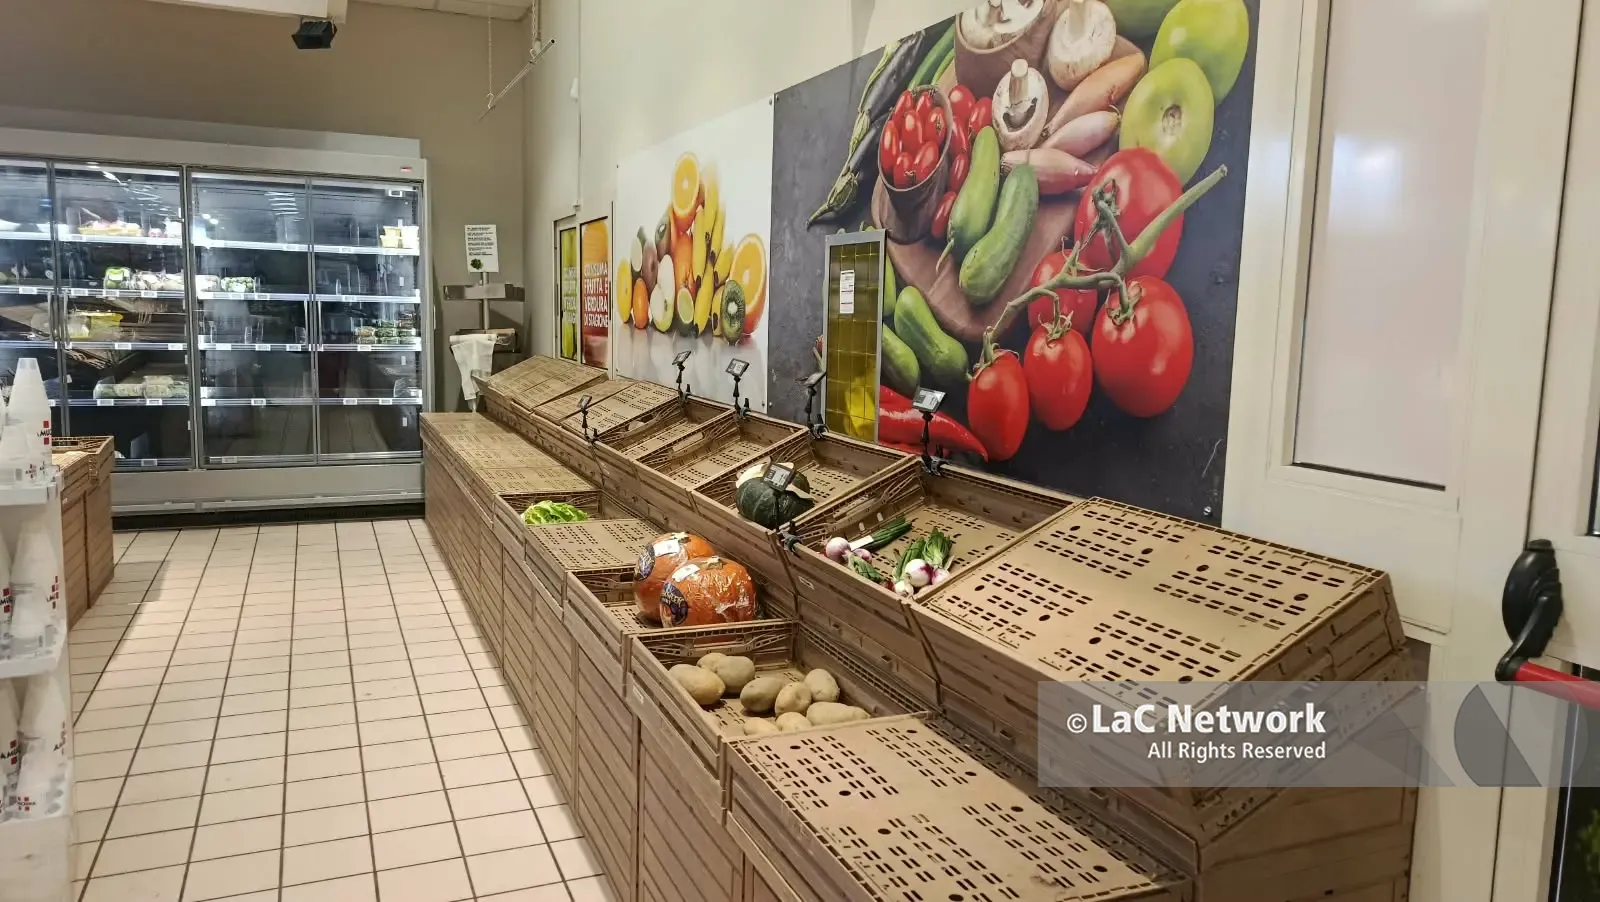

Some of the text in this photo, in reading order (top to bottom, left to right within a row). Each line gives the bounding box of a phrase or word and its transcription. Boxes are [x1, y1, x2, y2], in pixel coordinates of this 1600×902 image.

[584, 262, 608, 276] CONSUMA
[584, 278, 603, 294] FRUTTA
[584, 295, 609, 312] VERDURA
[588, 314, 609, 327] STAGIONE
